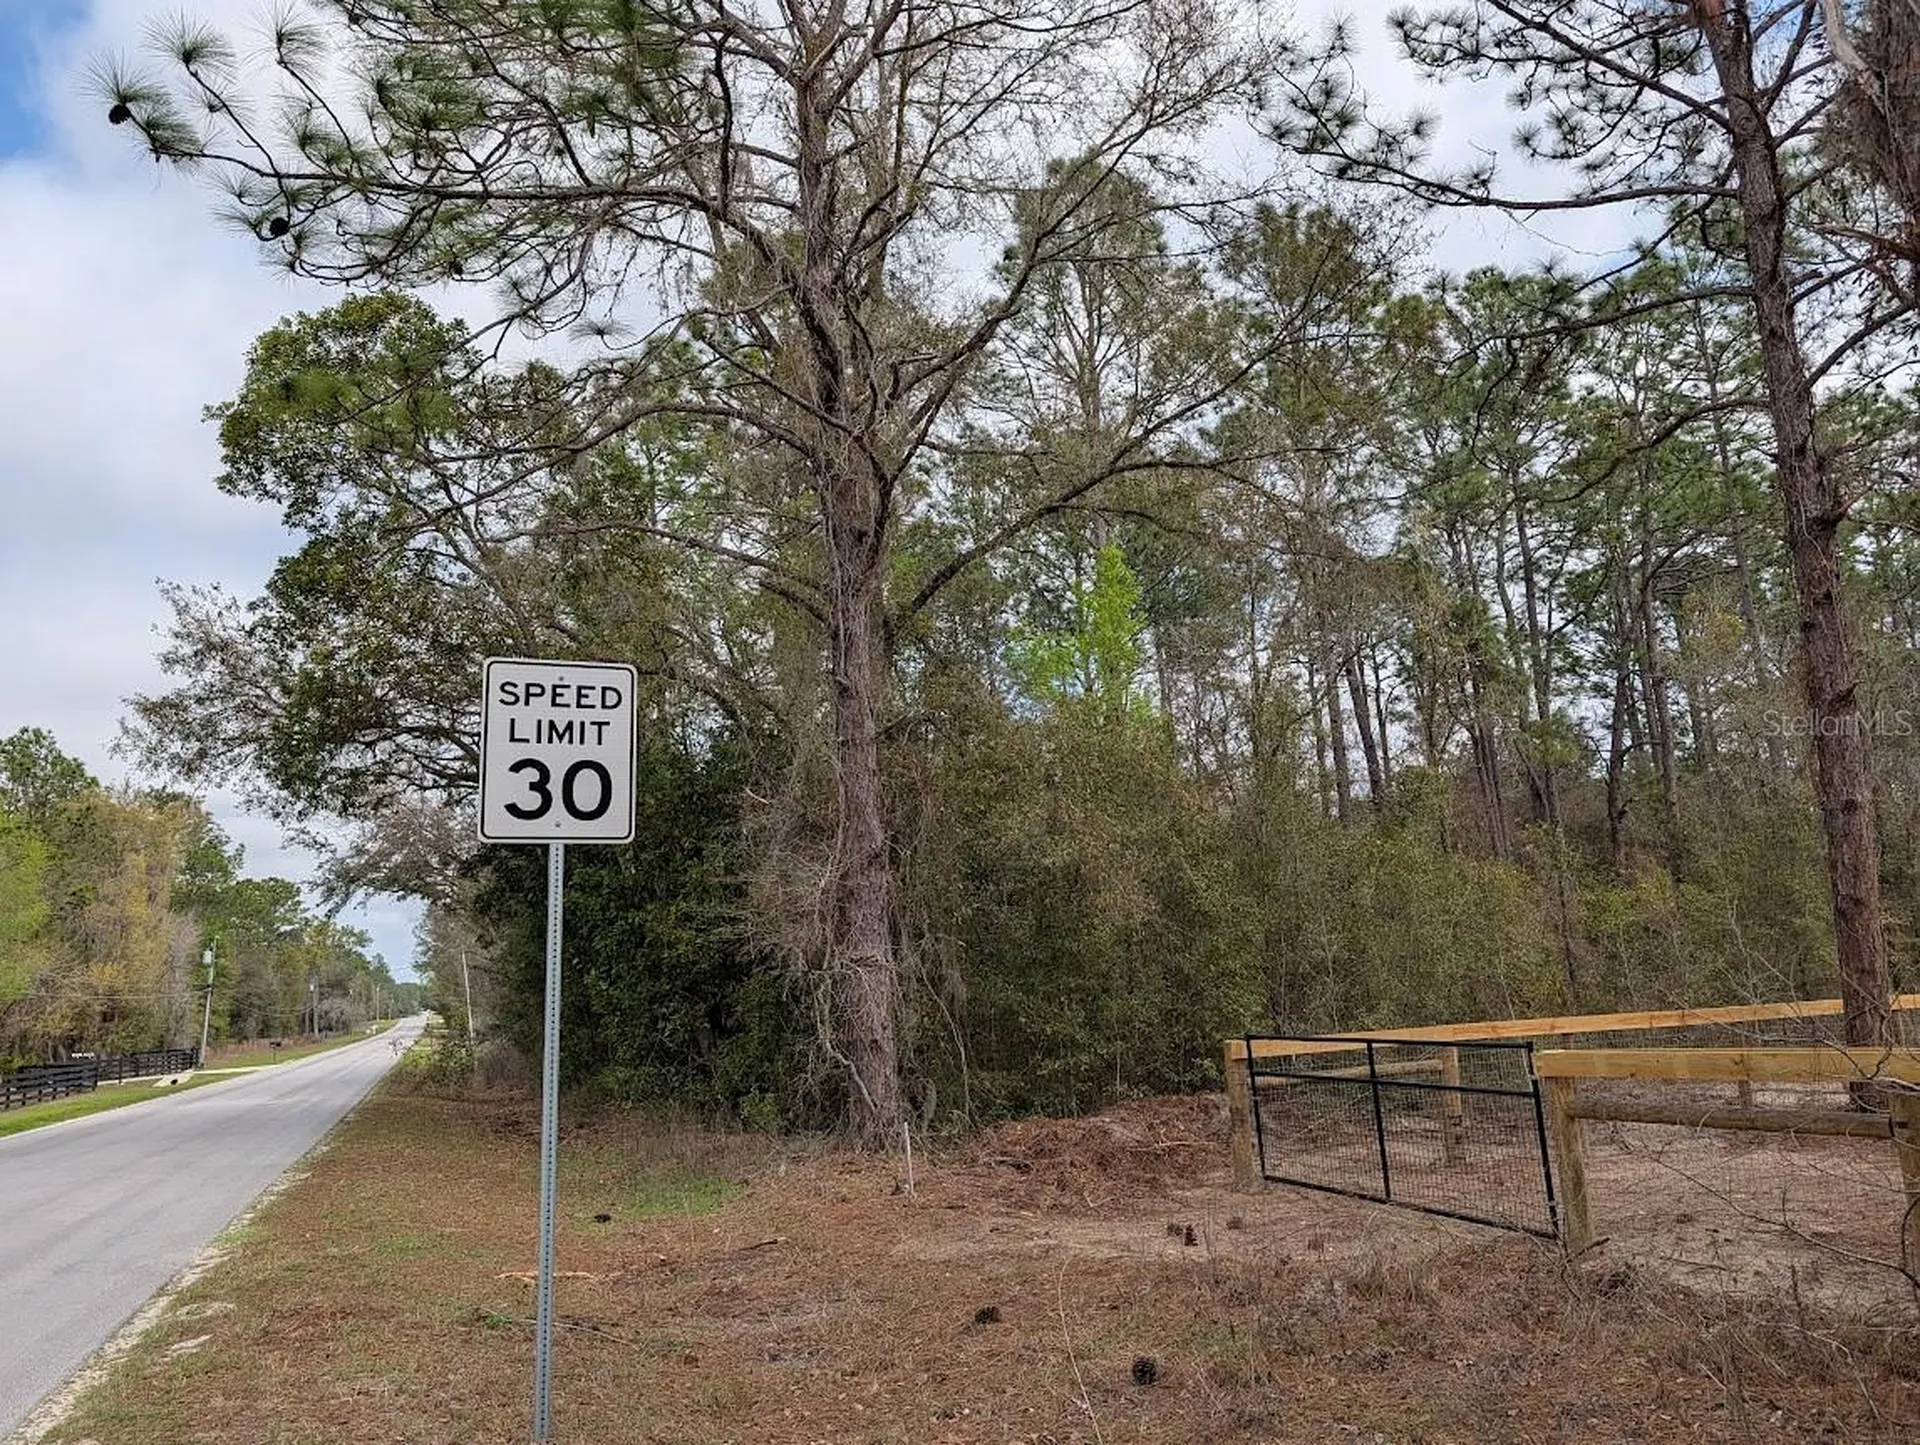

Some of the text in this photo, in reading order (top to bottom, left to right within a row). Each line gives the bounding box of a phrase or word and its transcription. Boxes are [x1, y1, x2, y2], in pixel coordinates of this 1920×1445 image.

[498, 681, 623, 710] SPEED
[508, 717, 611, 746] LIMIT
[503, 757, 613, 821] 30
